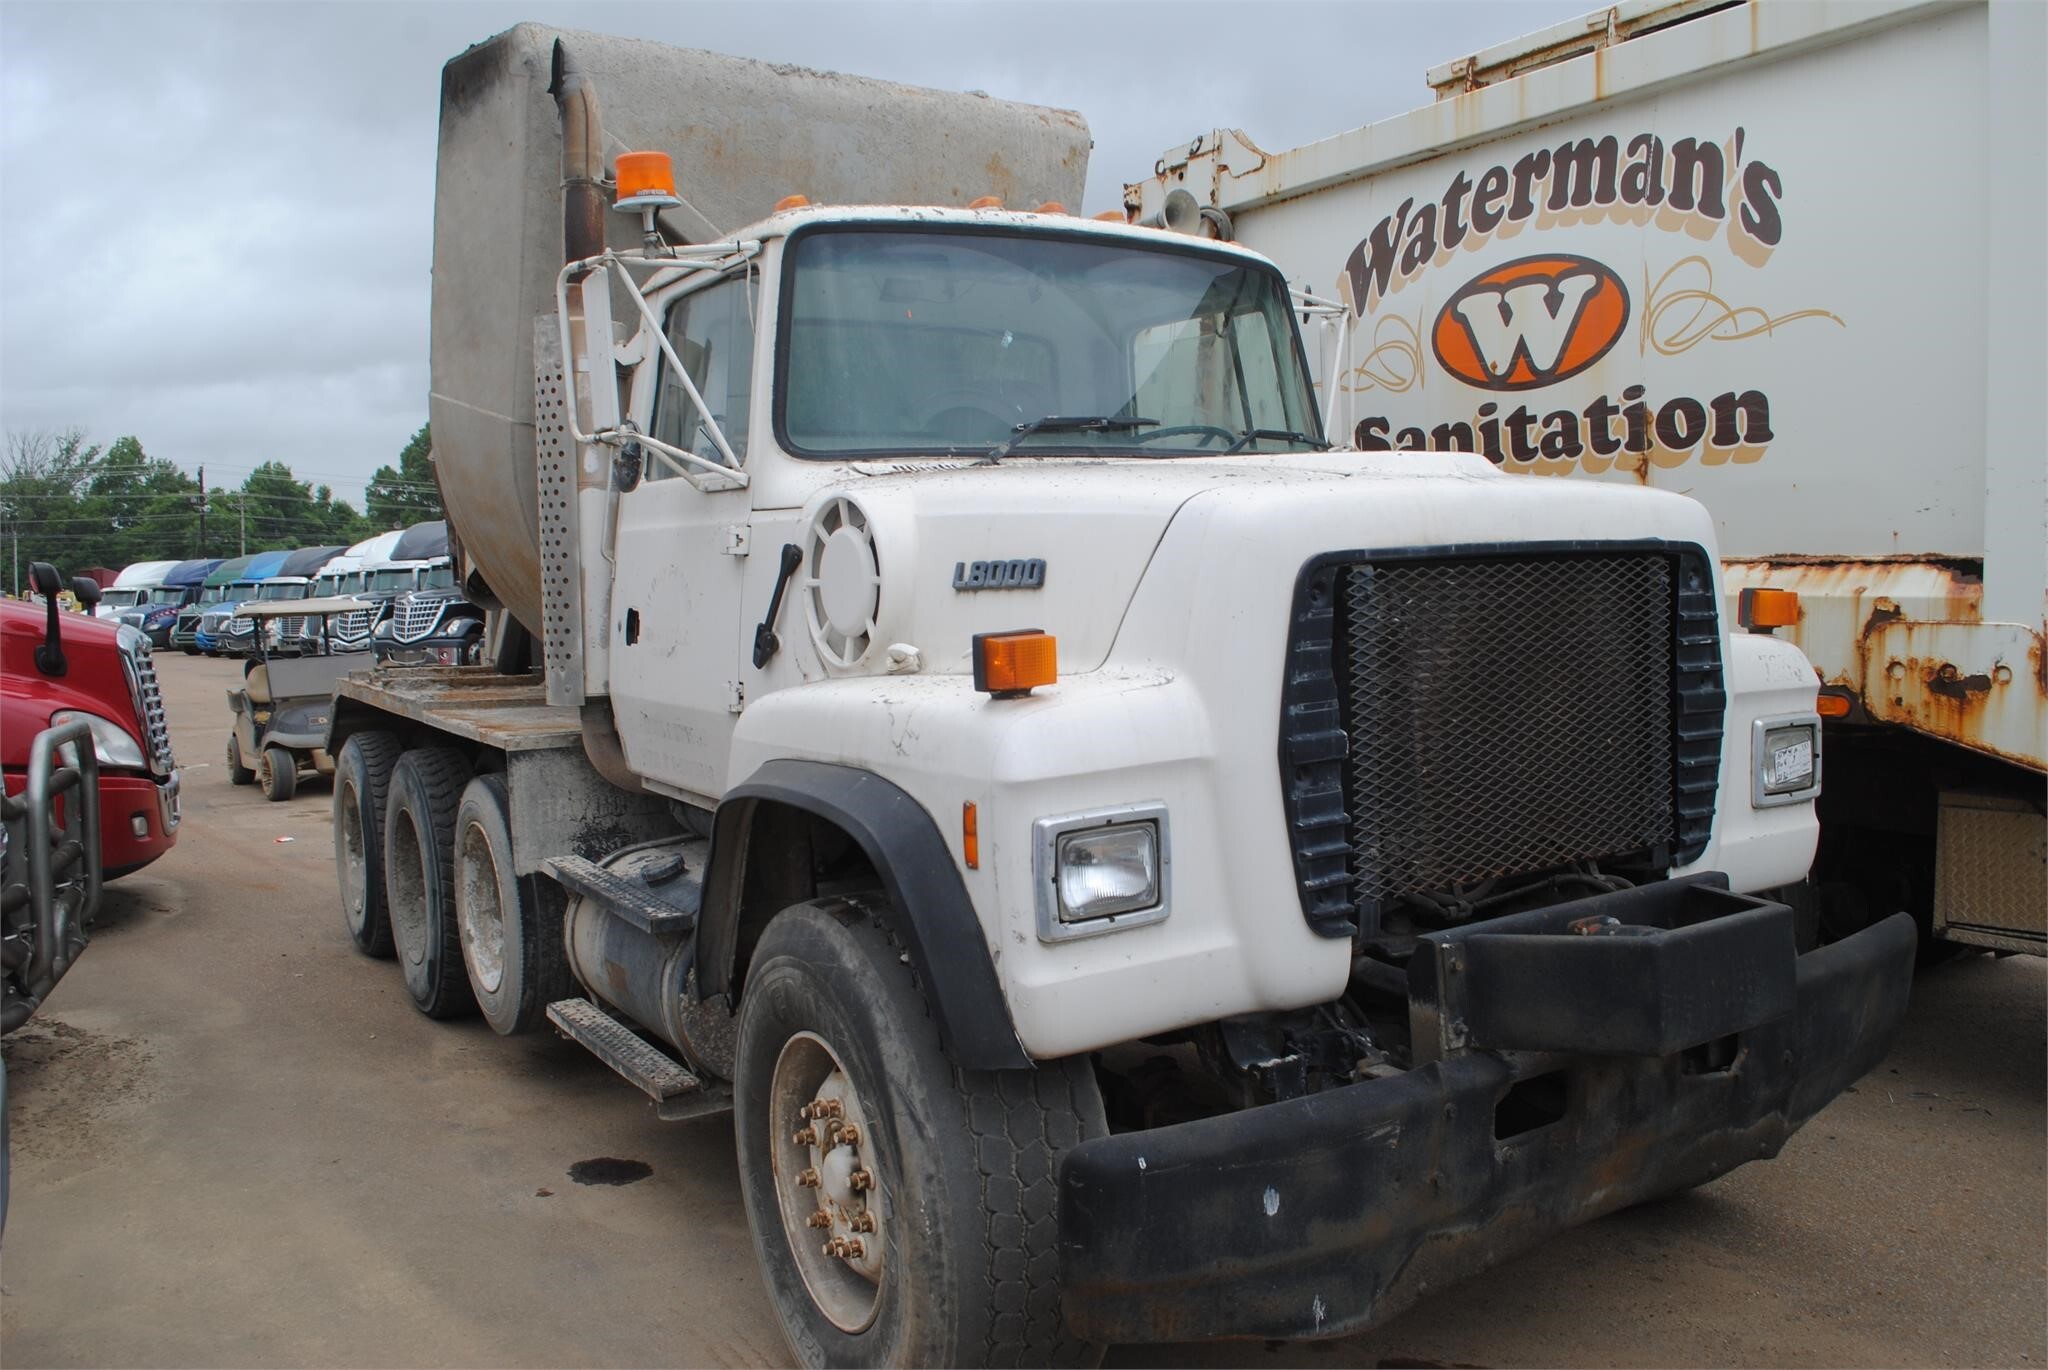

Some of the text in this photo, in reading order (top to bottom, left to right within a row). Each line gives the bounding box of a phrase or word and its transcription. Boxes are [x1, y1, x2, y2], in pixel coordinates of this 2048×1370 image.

[1345, 126, 1783, 318] Waterman's
[1455, 273, 1598, 376] W
[952, 558, 1047, 591] L8000
